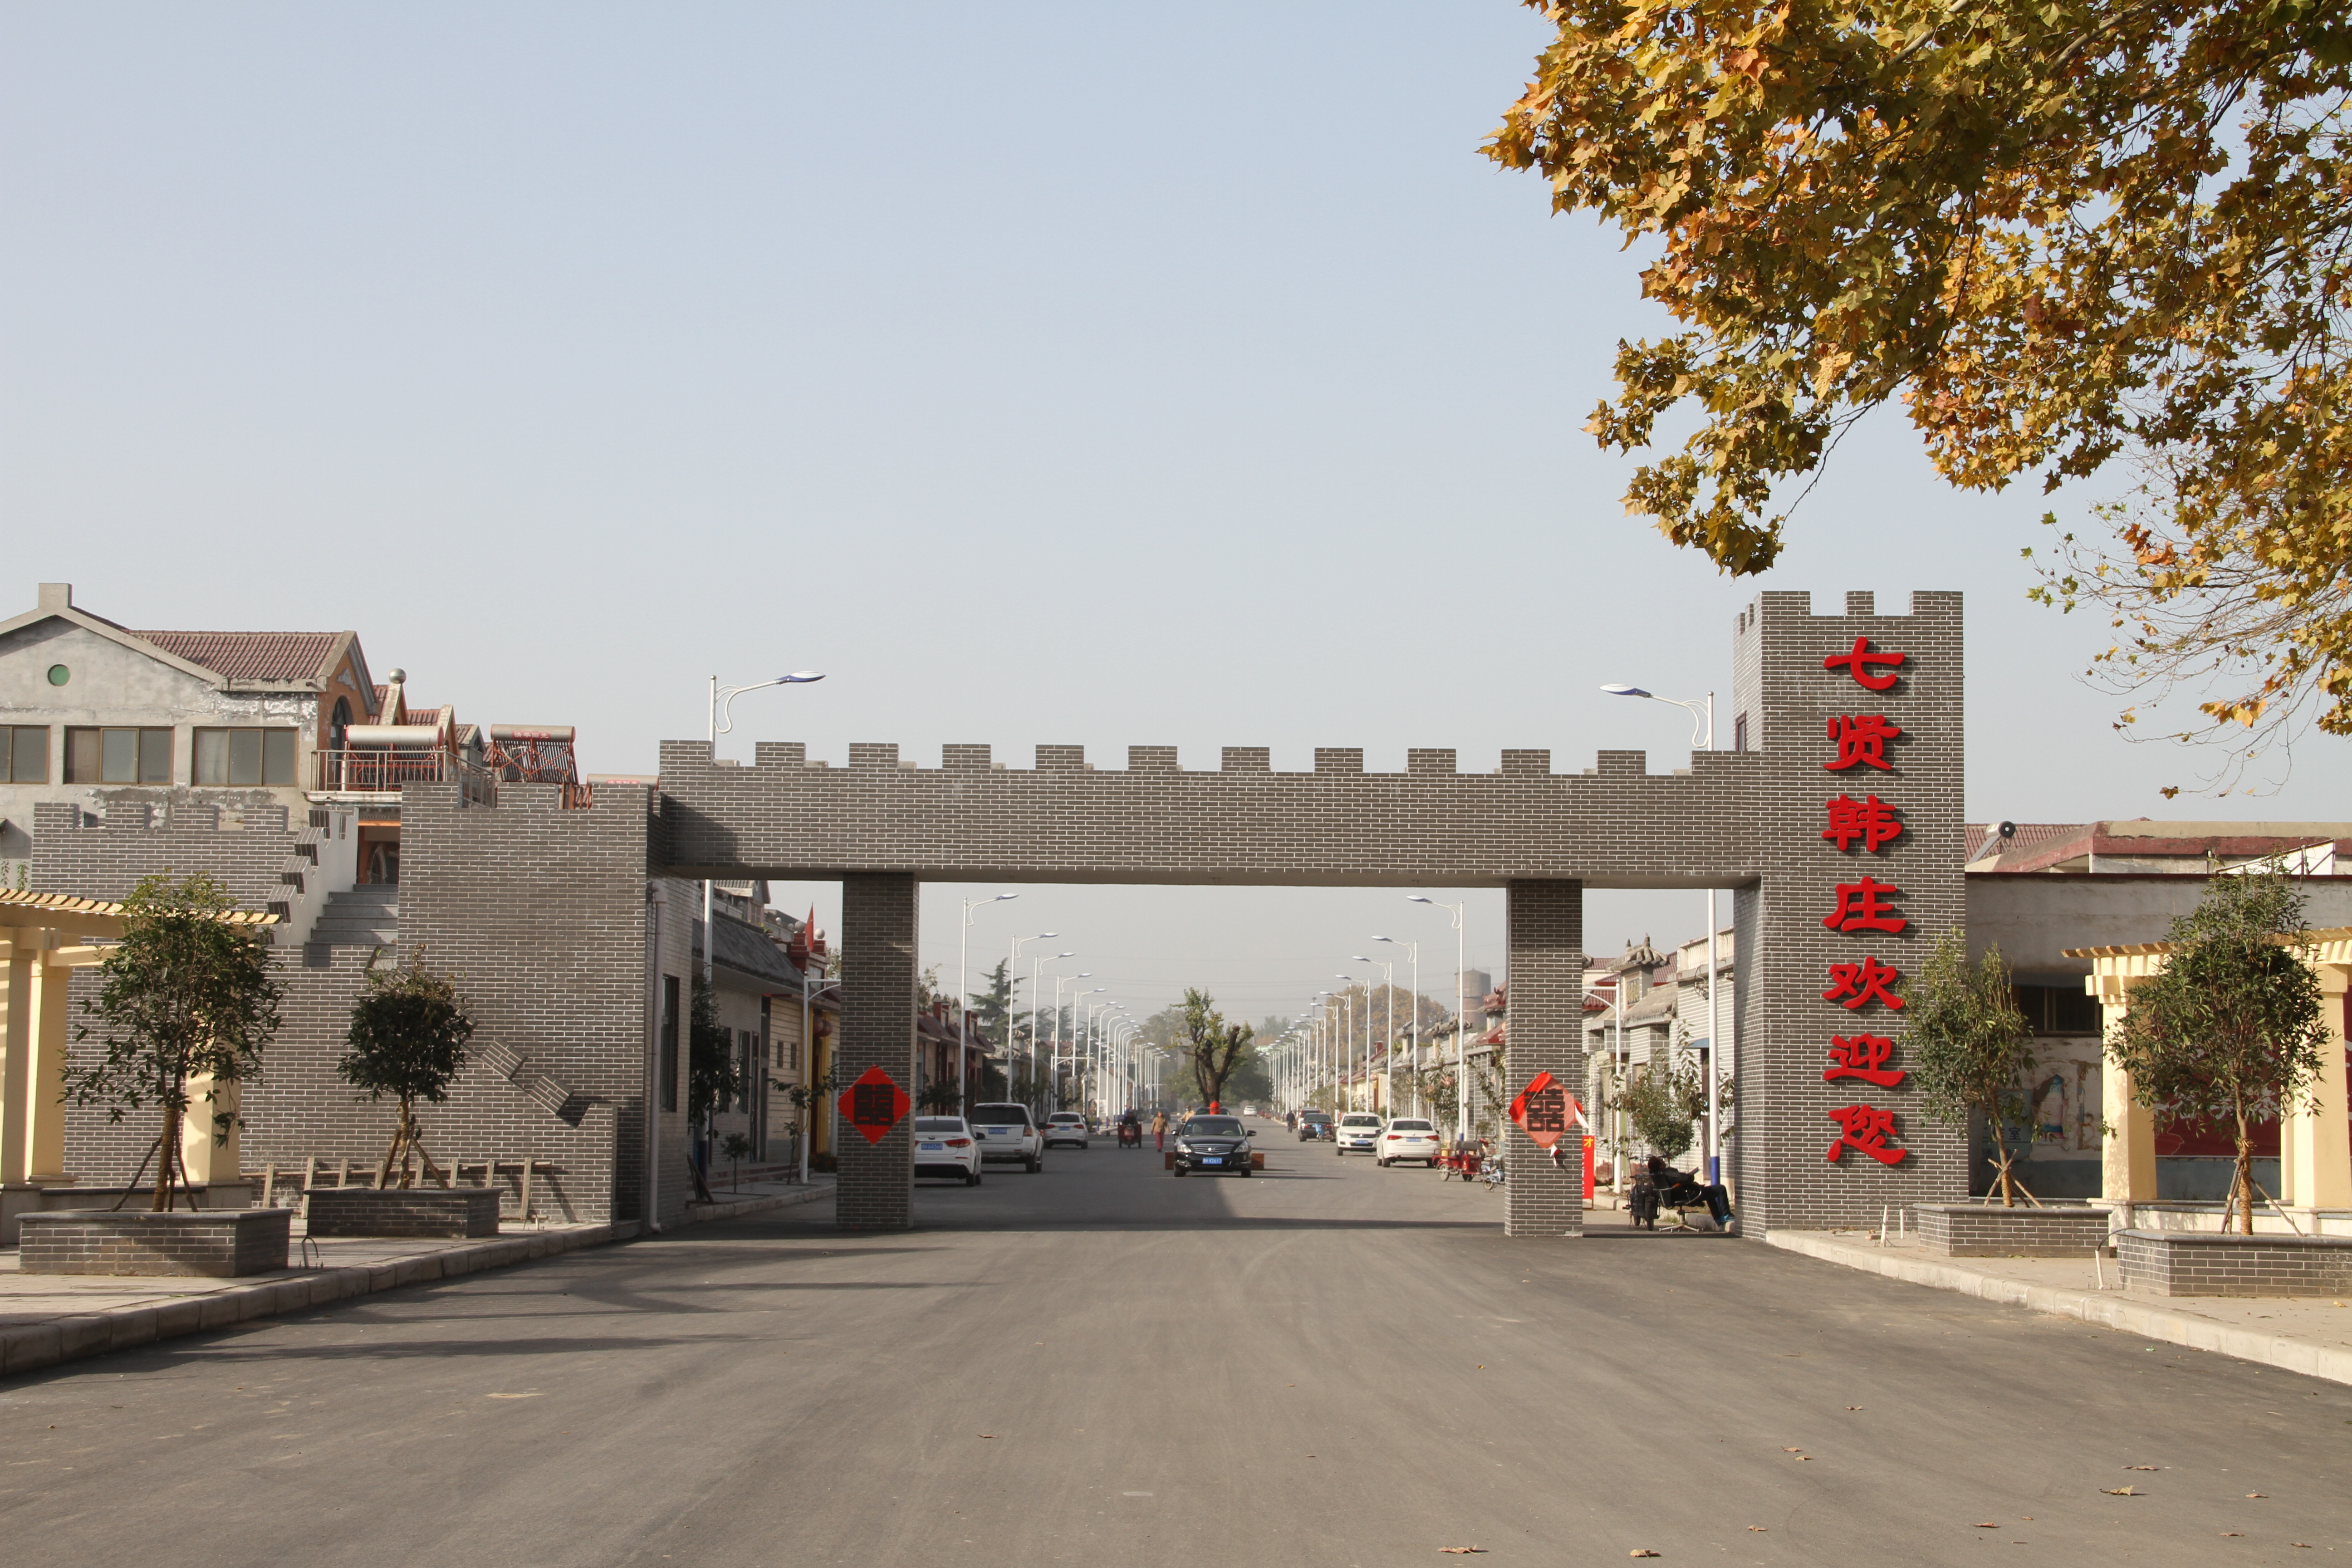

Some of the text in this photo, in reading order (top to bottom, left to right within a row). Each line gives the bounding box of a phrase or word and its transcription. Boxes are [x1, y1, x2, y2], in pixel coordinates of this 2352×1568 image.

[1822, 637, 1906, 1164] 七贤韩庄欢迎您
